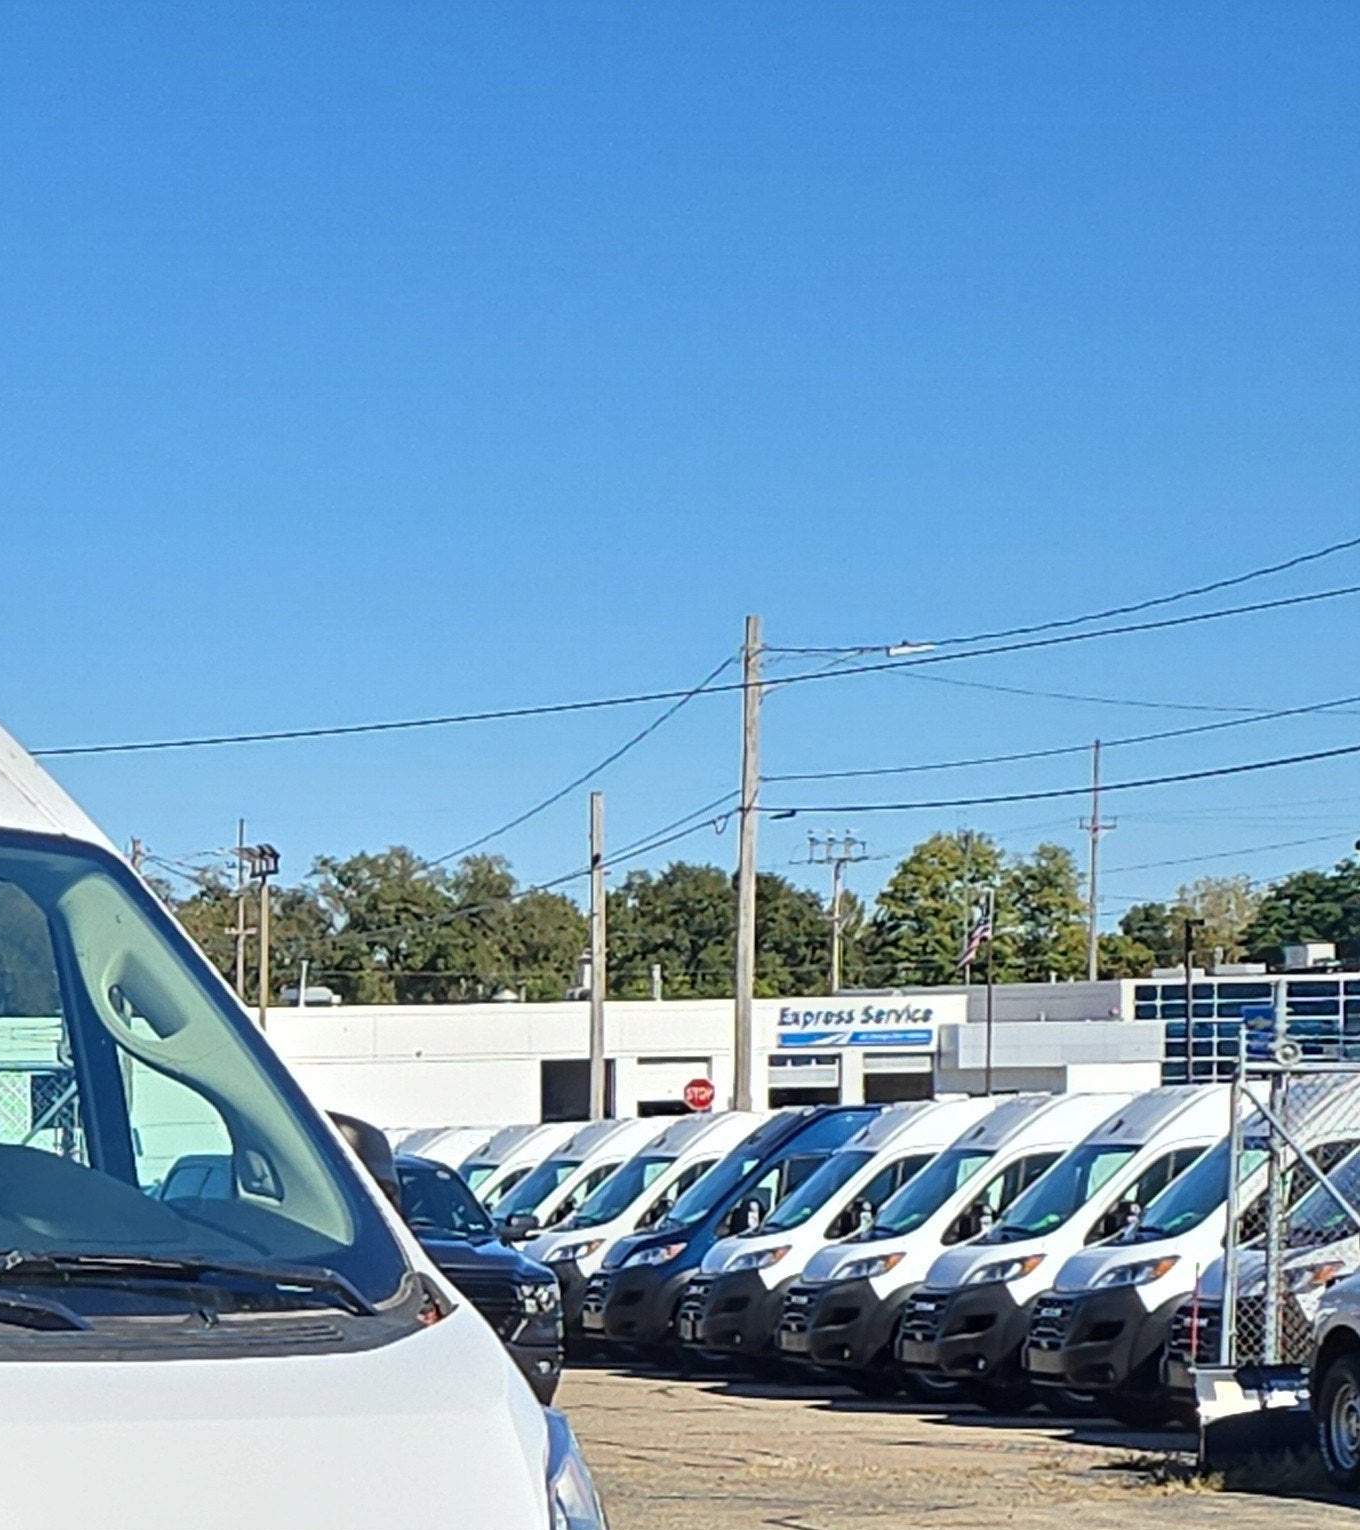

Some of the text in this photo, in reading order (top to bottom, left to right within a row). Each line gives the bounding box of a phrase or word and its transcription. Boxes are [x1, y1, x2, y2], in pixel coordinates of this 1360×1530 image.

[777, 1003, 934, 1030] Express Service
[686, 1086, 713, 1101] STOP
